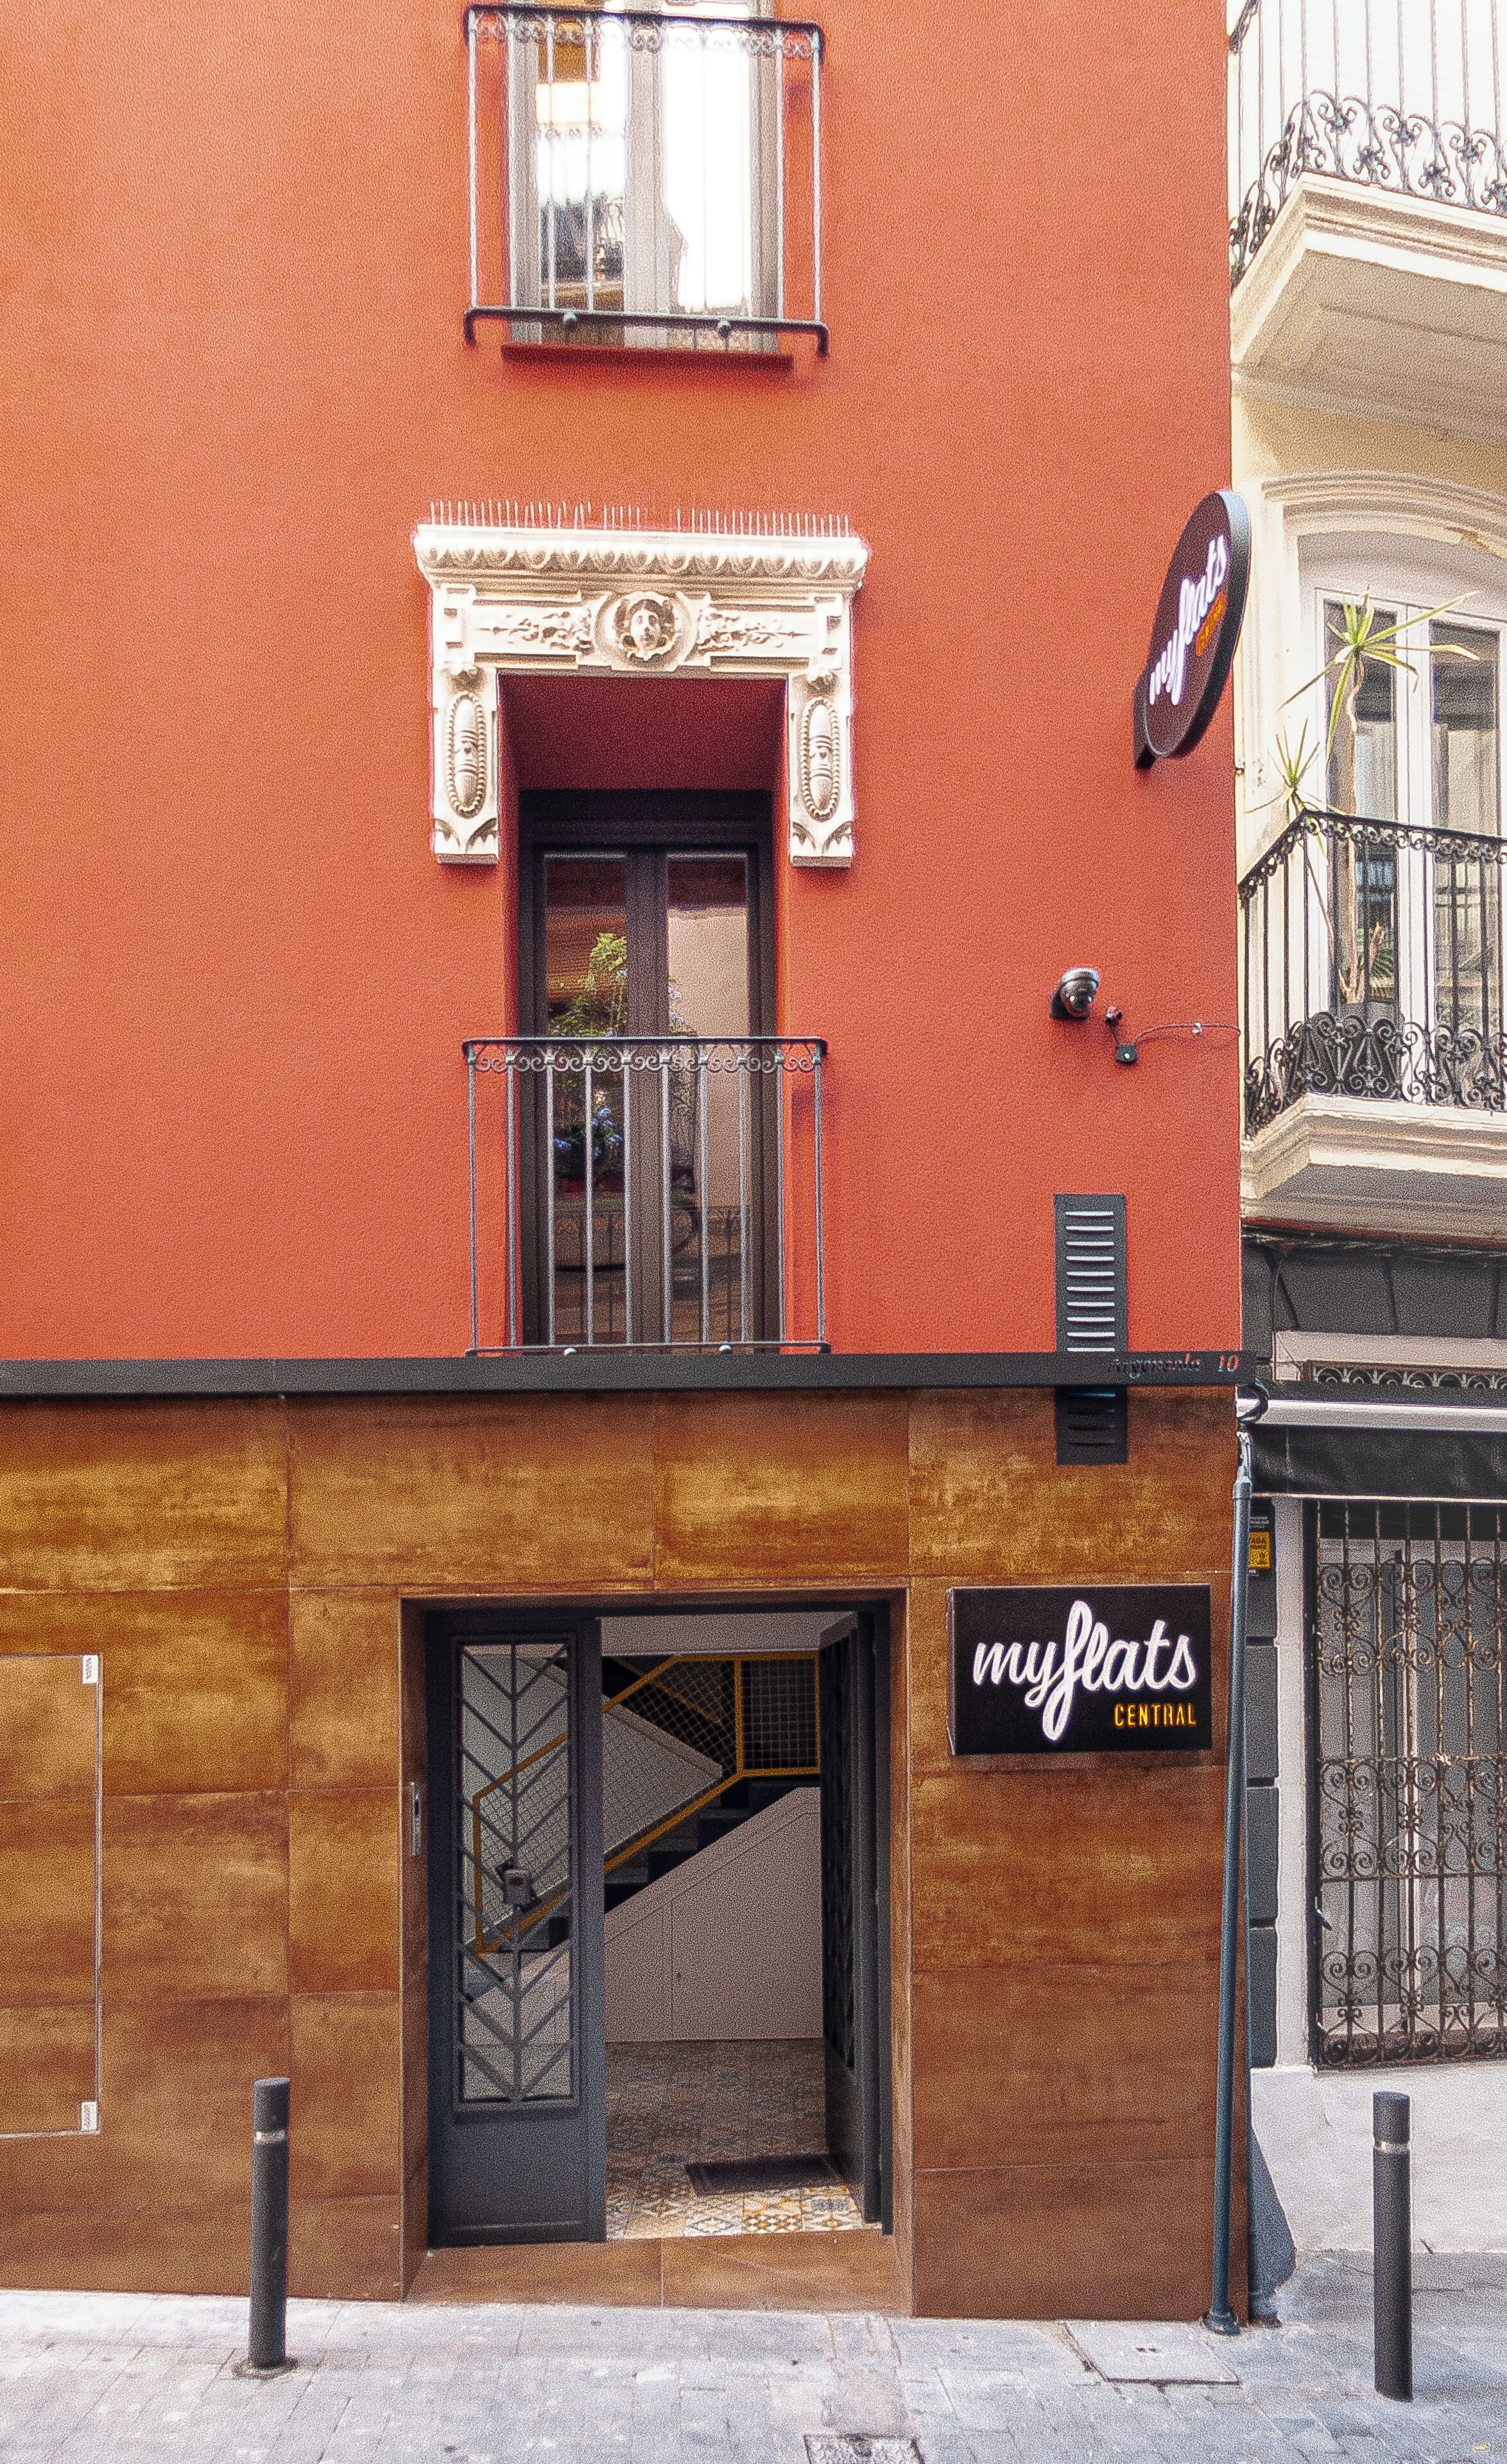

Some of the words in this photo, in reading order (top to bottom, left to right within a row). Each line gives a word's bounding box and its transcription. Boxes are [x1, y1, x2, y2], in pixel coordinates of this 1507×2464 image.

[1218, 1354, 1239, 1373] 10
[973, 1600, 1198, 1741] myflats
[1114, 1702, 1196, 1728] CENTRAL
